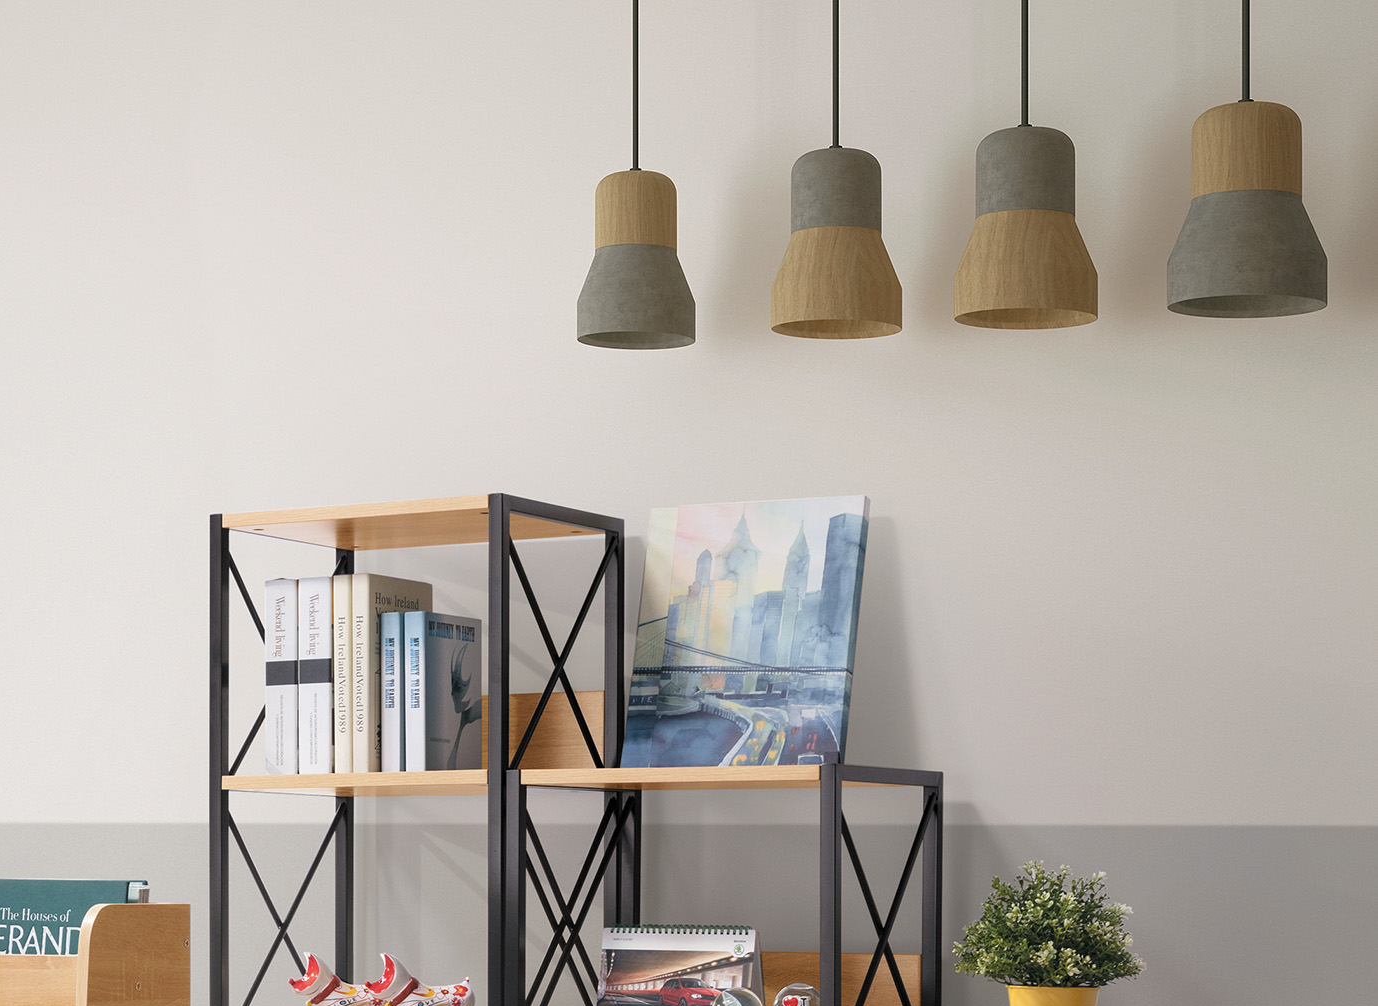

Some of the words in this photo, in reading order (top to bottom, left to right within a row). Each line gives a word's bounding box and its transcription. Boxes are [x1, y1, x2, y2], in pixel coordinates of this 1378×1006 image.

[375, 592, 391, 606] How
[394, 595, 419, 610] Ireland
[275, 596, 285, 633] Weekend
[308, 594, 319, 630] Weekend
[272, 636, 285, 657] living
[306, 634, 319, 655] living
[385, 638, 394, 647] MY
[410, 638, 419, 647] MY
[385, 649, 394, 676] JOURNEY
[410, 649, 419, 676] JOURNEY
[385, 678, 394, 687] TO
[410, 678, 419, 687] TO
[385, 688, 394, 708] EARTH
[410, 688, 419, 708] EARTH
[0, 908, 19, 920] The
[22, 908, 58, 922] Houses
[60, 909, 71, 922] of
